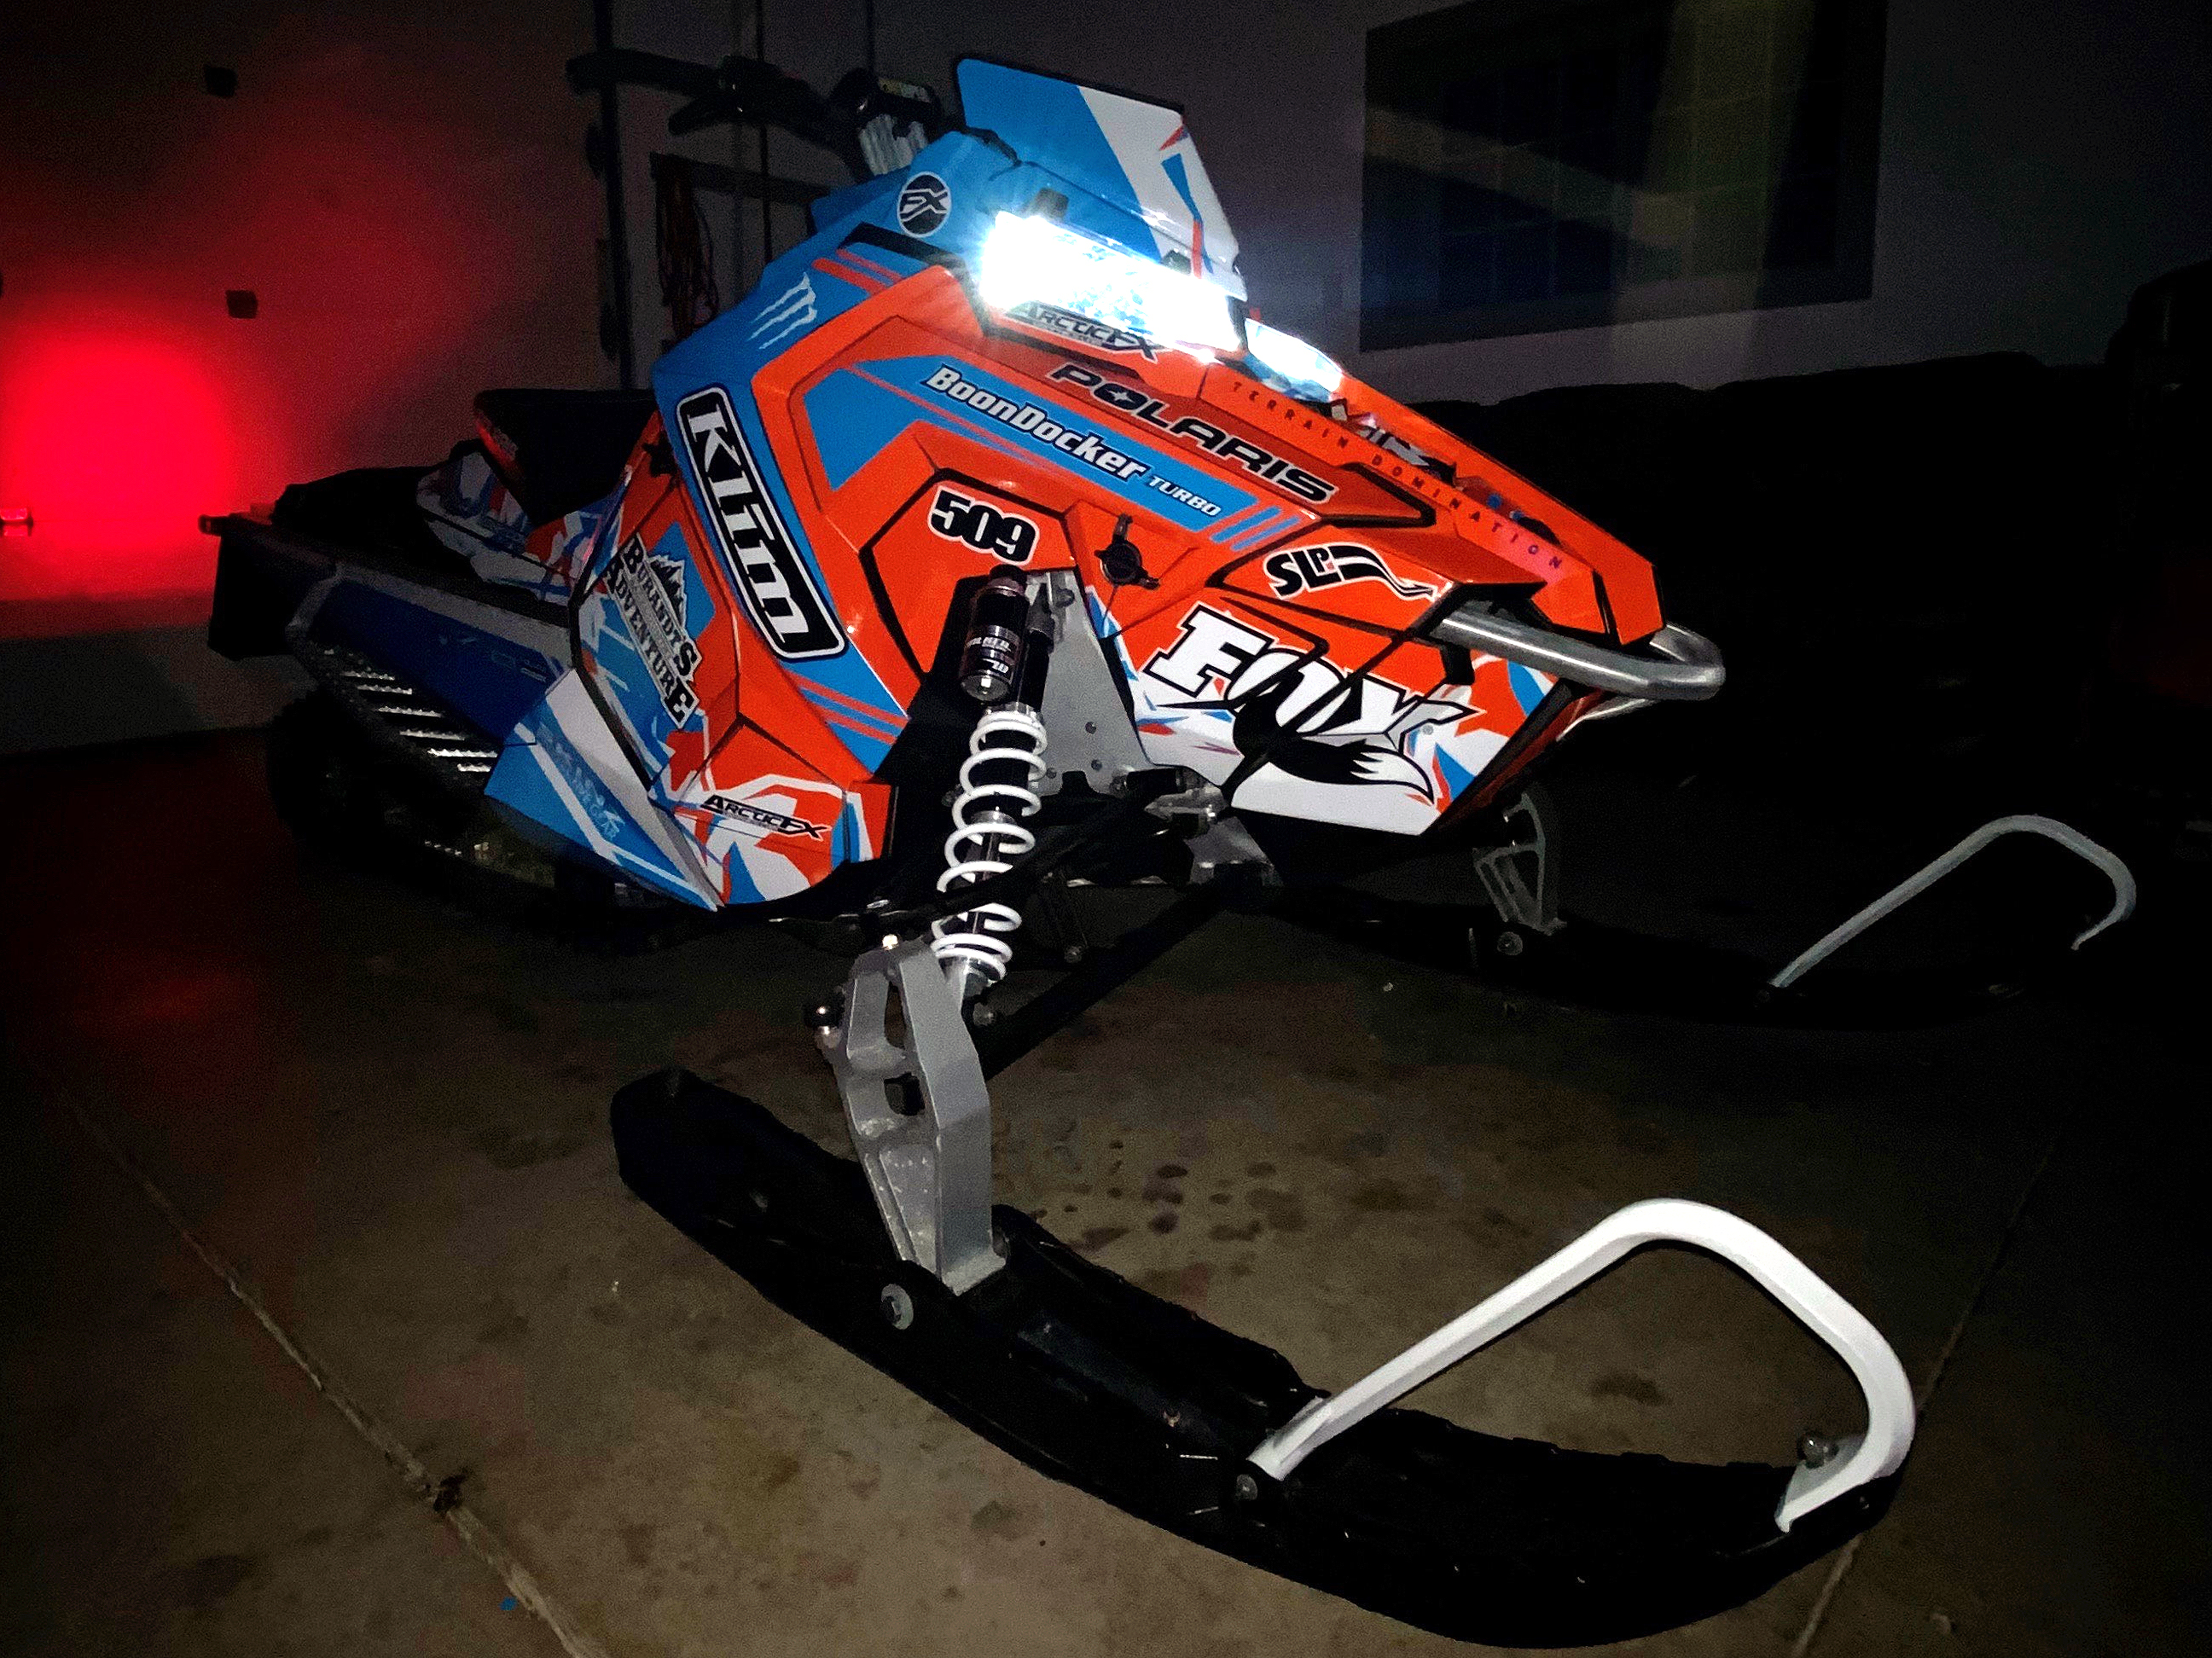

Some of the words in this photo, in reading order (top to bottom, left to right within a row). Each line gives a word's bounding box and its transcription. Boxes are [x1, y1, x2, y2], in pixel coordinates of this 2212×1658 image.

[925, 365, 1149, 481] BoonDocker
[1148, 475, 1222, 517] TURBO
[1048, 364, 1337, 502] POLARIS
[1233, 380, 1350, 449] TERRAIN
[1371, 453, 1563, 570] DOMINATION
[929, 487, 1039, 564] 509
[1266, 547, 1343, 597] SLP
[603, 554, 699, 724] ADVENTURE
[1141, 601, 1484, 751] FOX
